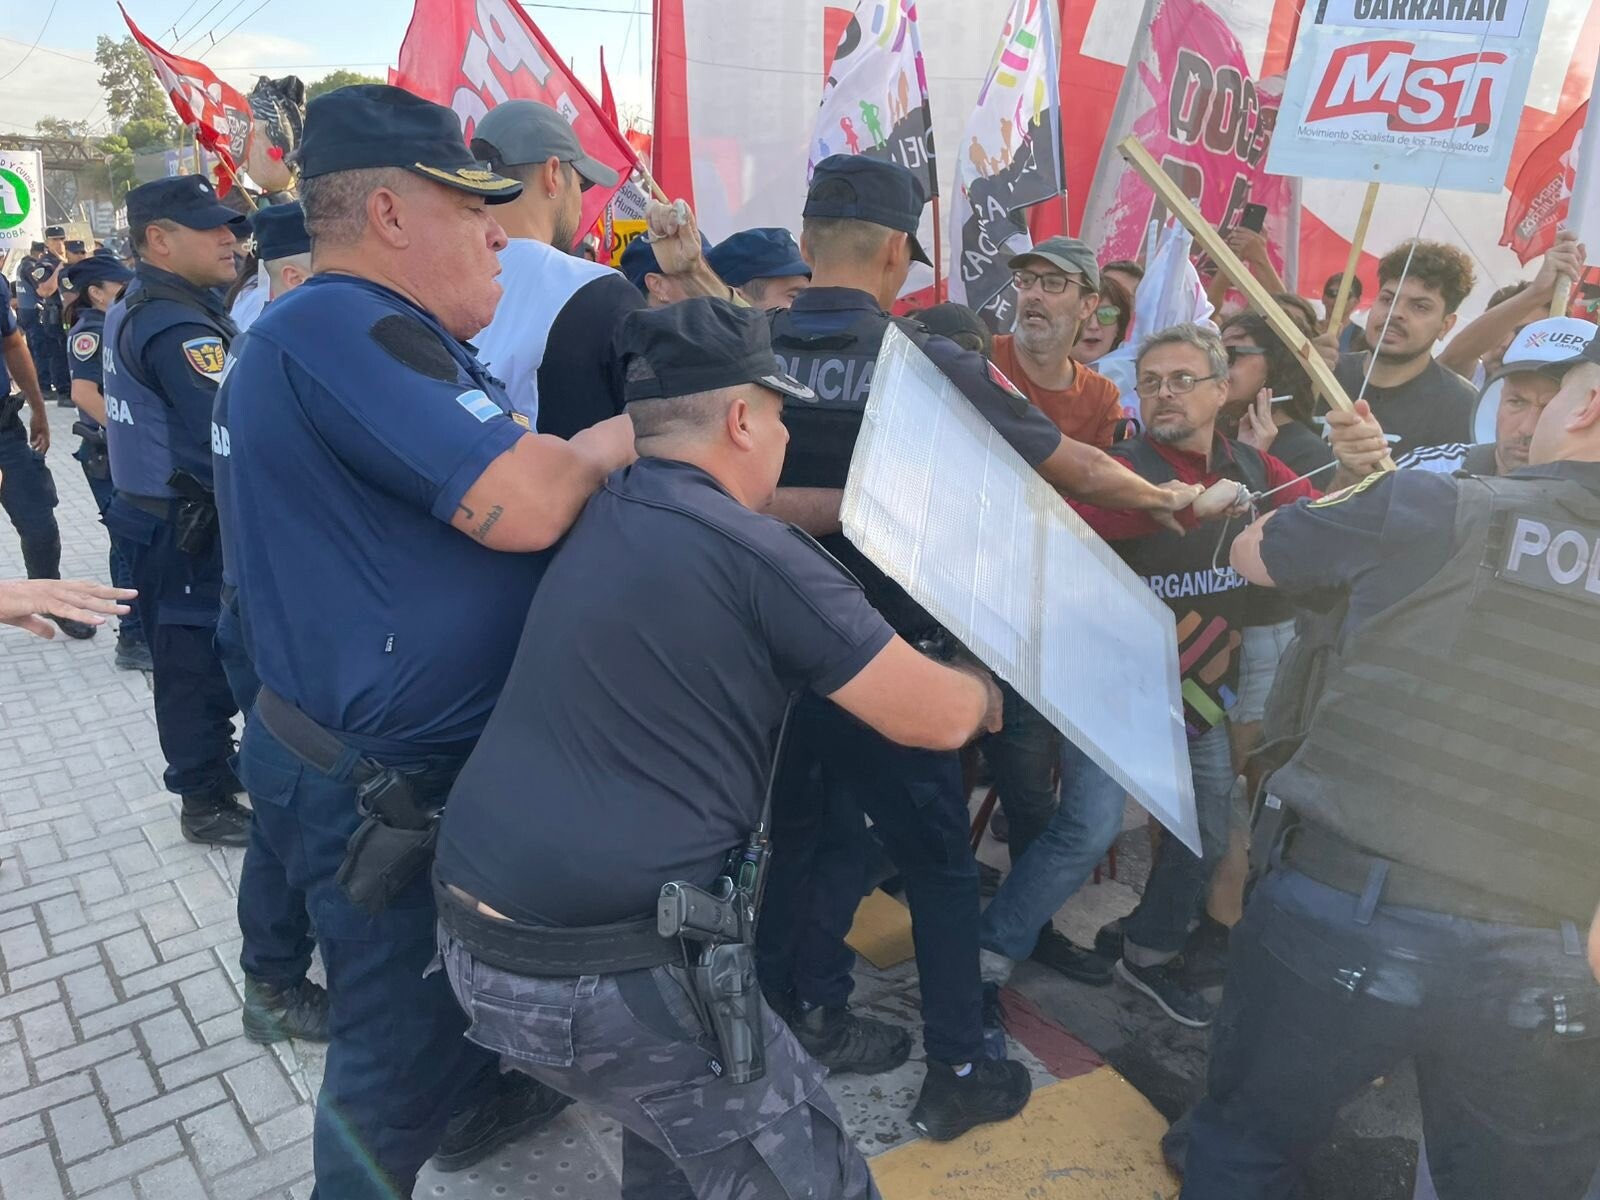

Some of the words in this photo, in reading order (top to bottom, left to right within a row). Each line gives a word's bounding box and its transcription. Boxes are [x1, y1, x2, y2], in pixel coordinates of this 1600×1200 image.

[1325, 51, 1502, 125] MST
[1297, 125, 1350, 140] Movimiento
[1351, 129, 1395, 144] Socialista
[1398, 134, 1410, 145] de
[1412, 135, 1426, 146] los
